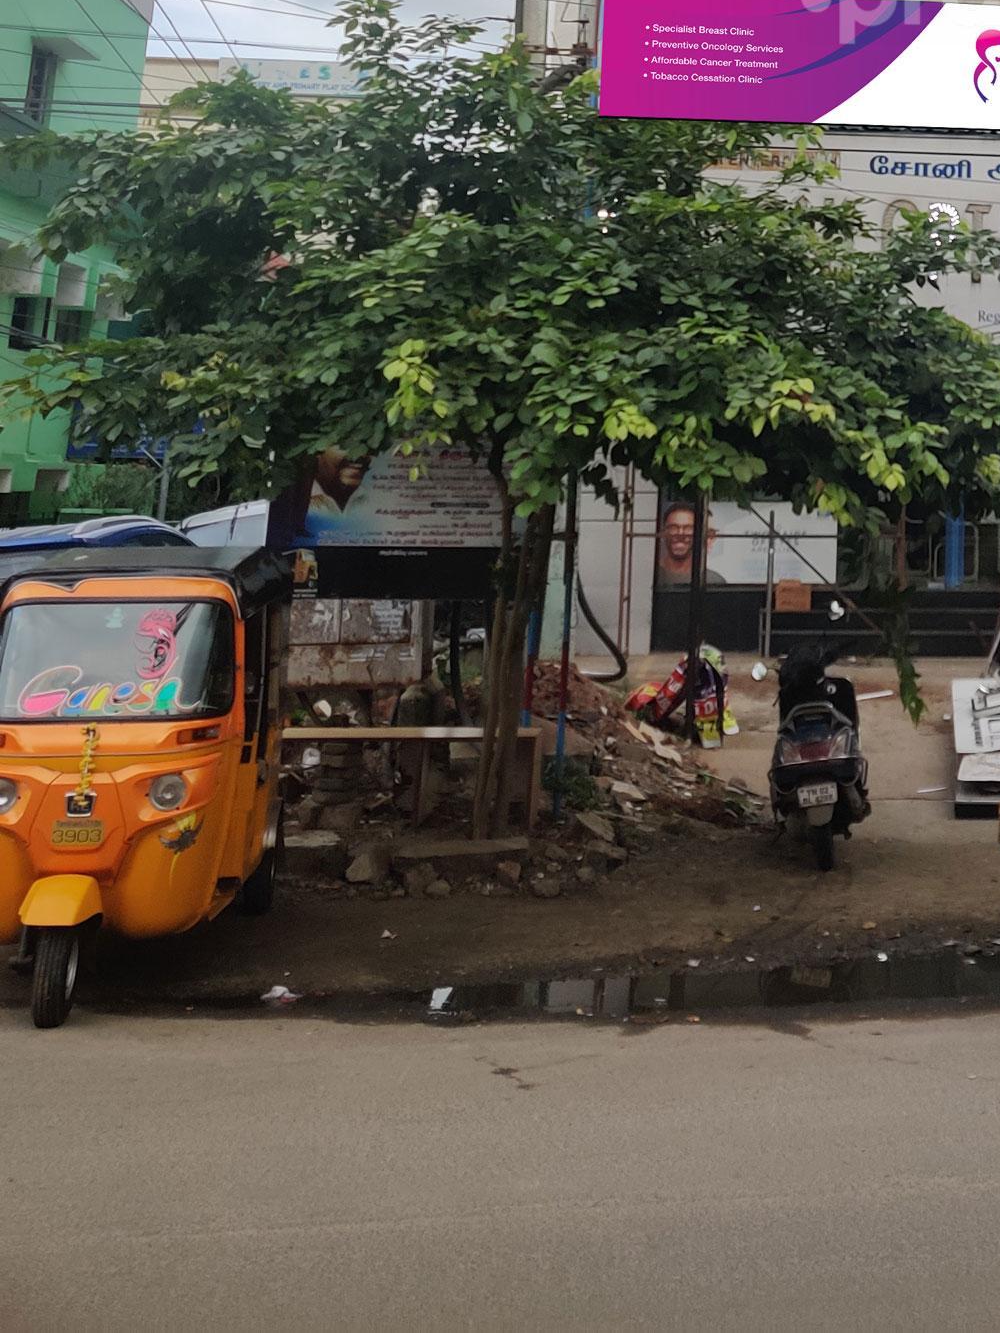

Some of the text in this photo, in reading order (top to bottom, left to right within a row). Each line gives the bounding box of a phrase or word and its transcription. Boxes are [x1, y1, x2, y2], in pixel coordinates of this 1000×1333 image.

[653, 24, 754, 36] Specialist Breast Clinic
[652, 40, 783, 53] Preventive Oncology Services
[651, 56, 778, 69] Affordable Cancer Treatment
[651, 71, 763, 84] Tobacco Cessation Clinic
[870, 155, 972, 179] சோனி
[17, 656, 201, 717] Ganesh
[52, 829, 102, 844] 3903
